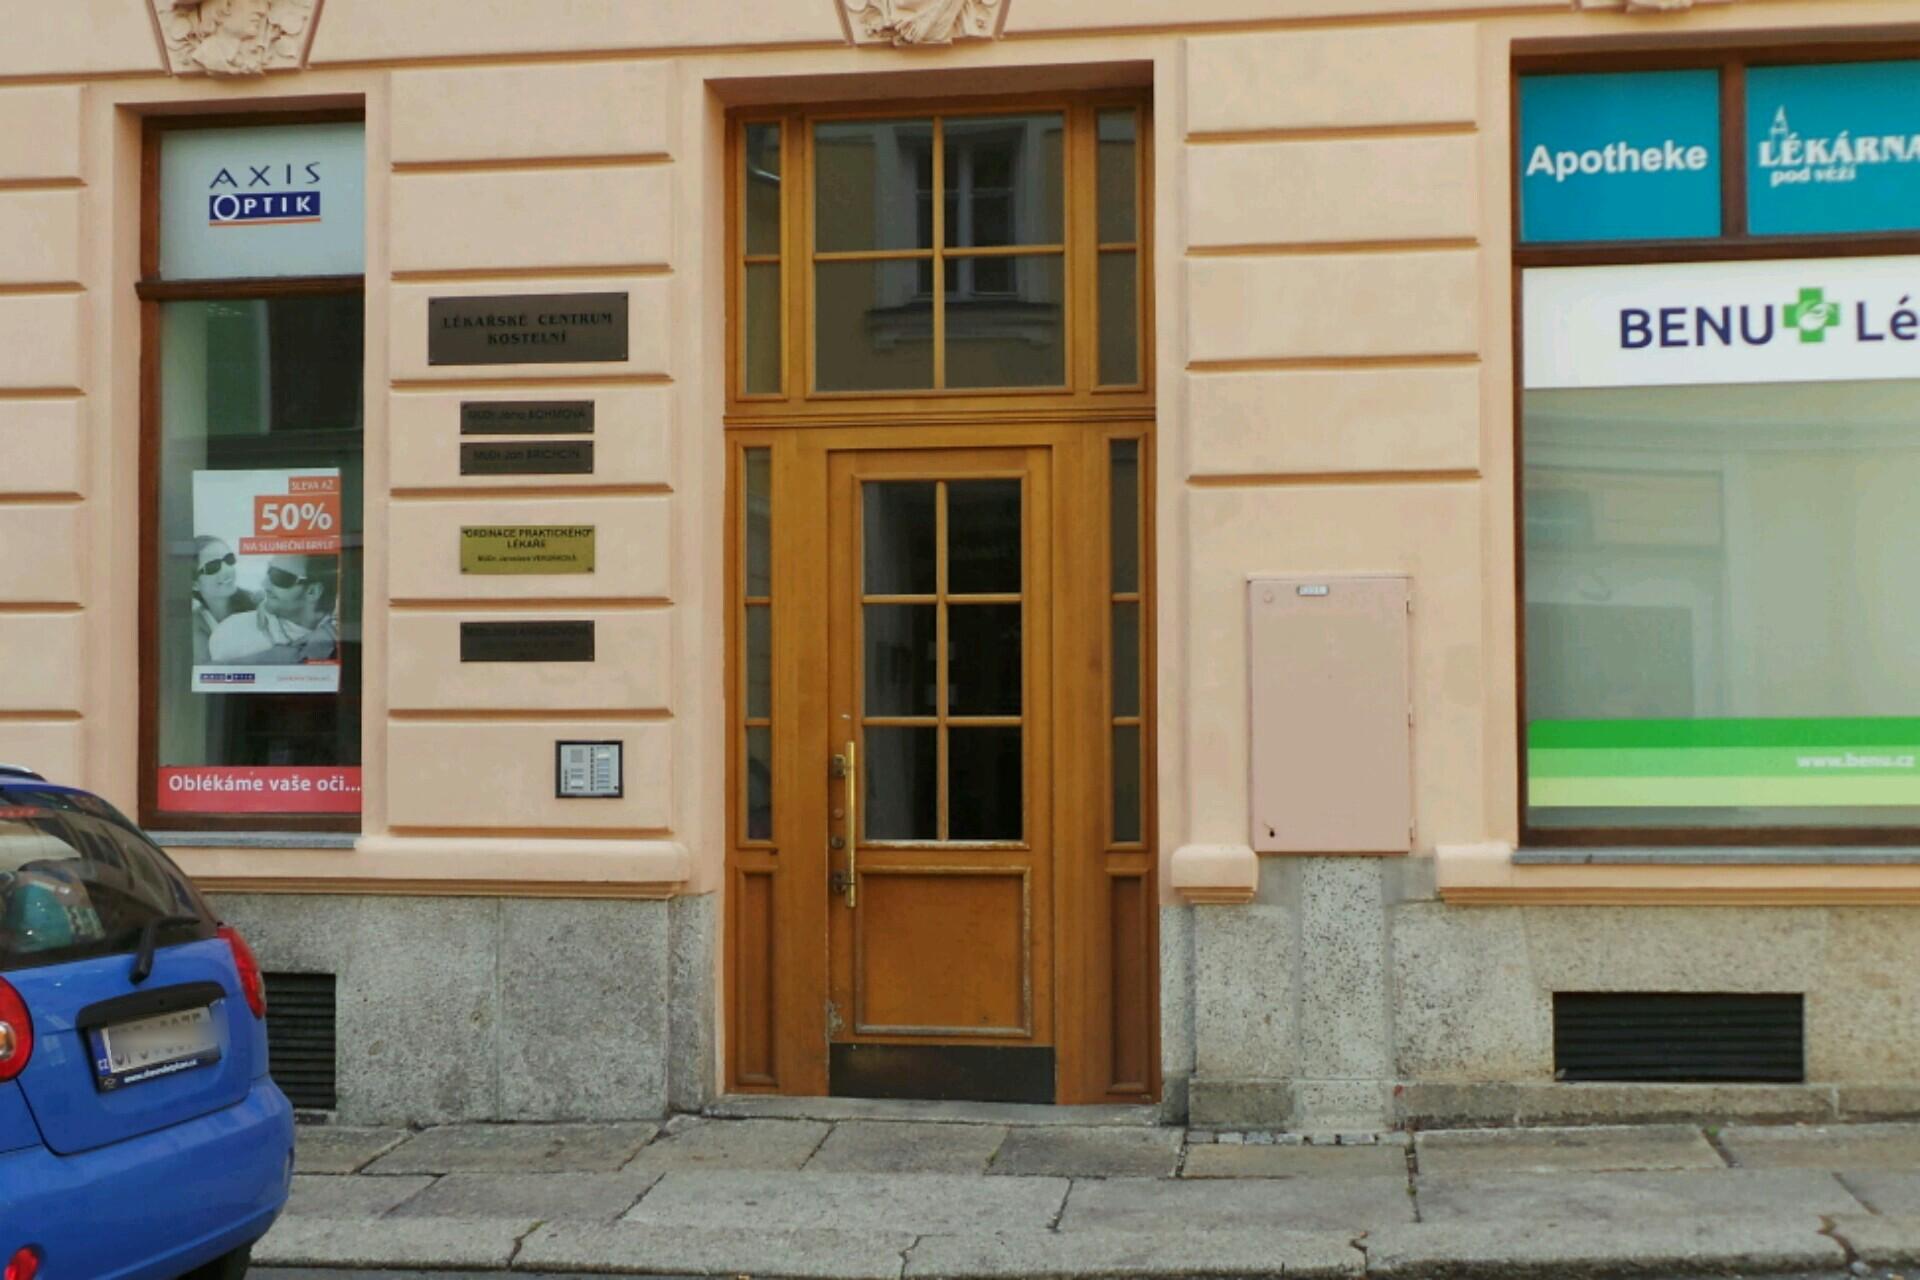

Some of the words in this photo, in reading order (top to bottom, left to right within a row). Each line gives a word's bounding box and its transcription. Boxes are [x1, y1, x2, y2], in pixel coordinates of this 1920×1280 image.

[1526, 140, 1708, 182] Apotheke
[209, 162, 320, 189] AXIS
[1770, 167, 1811, 188] pod
[213, 194, 312, 220] OPTIK
[442, 314, 528, 328] LÉKAŘSKÉ
[537, 312, 613, 327] CENTRUM
[1619, 304, 1774, 349] BENU
[1856, 295, 1918, 342] Lé
[488, 330, 567, 345] KOSTELNÍ
[261, 502, 333, 531] 50%
[243, 541, 258, 551] NA
[168, 773, 263, 791] Oblékáme
[269, 775, 311, 791] vaše
[316, 776, 361, 791] oči...
